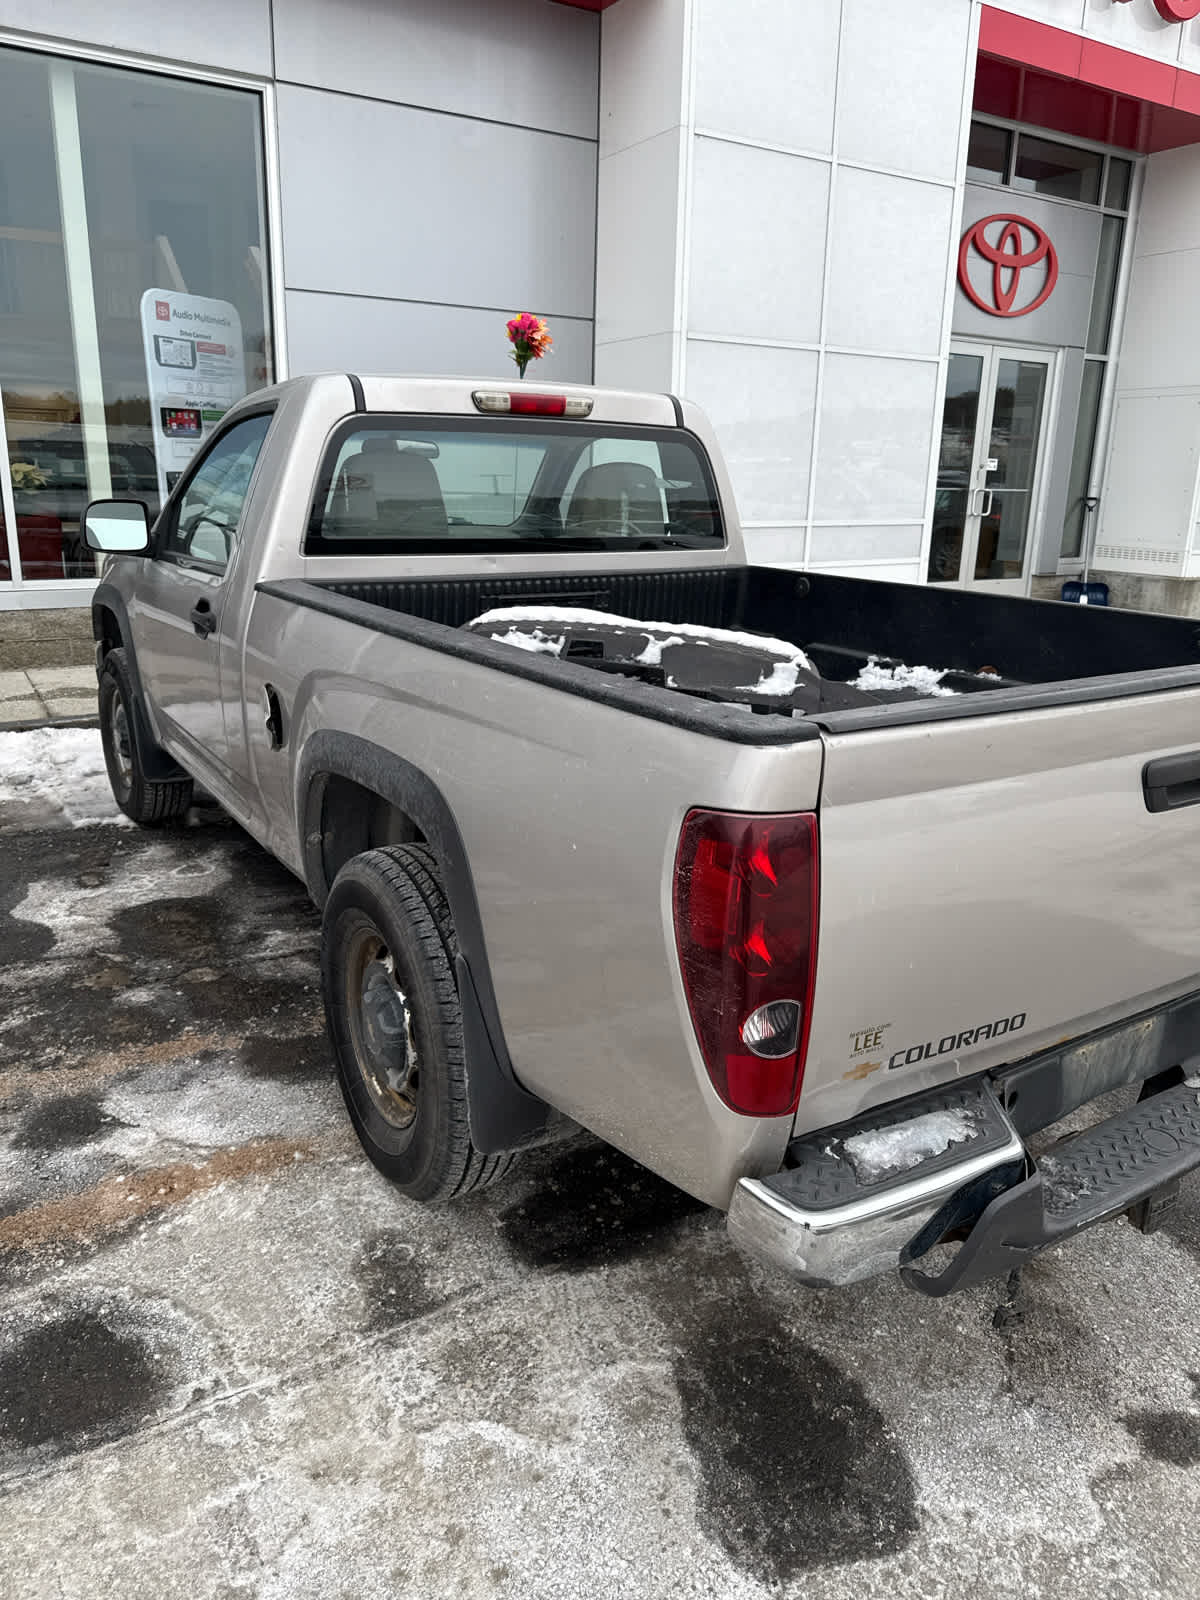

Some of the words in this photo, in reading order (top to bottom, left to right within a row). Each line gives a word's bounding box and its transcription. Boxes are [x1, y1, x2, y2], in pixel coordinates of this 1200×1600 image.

[172, 309, 193, 321] Audio
[193, 312, 231, 327] Multimedia
[854, 1030, 884, 1052] LEE
[888, 1012, 1027, 1070] COLORADO
